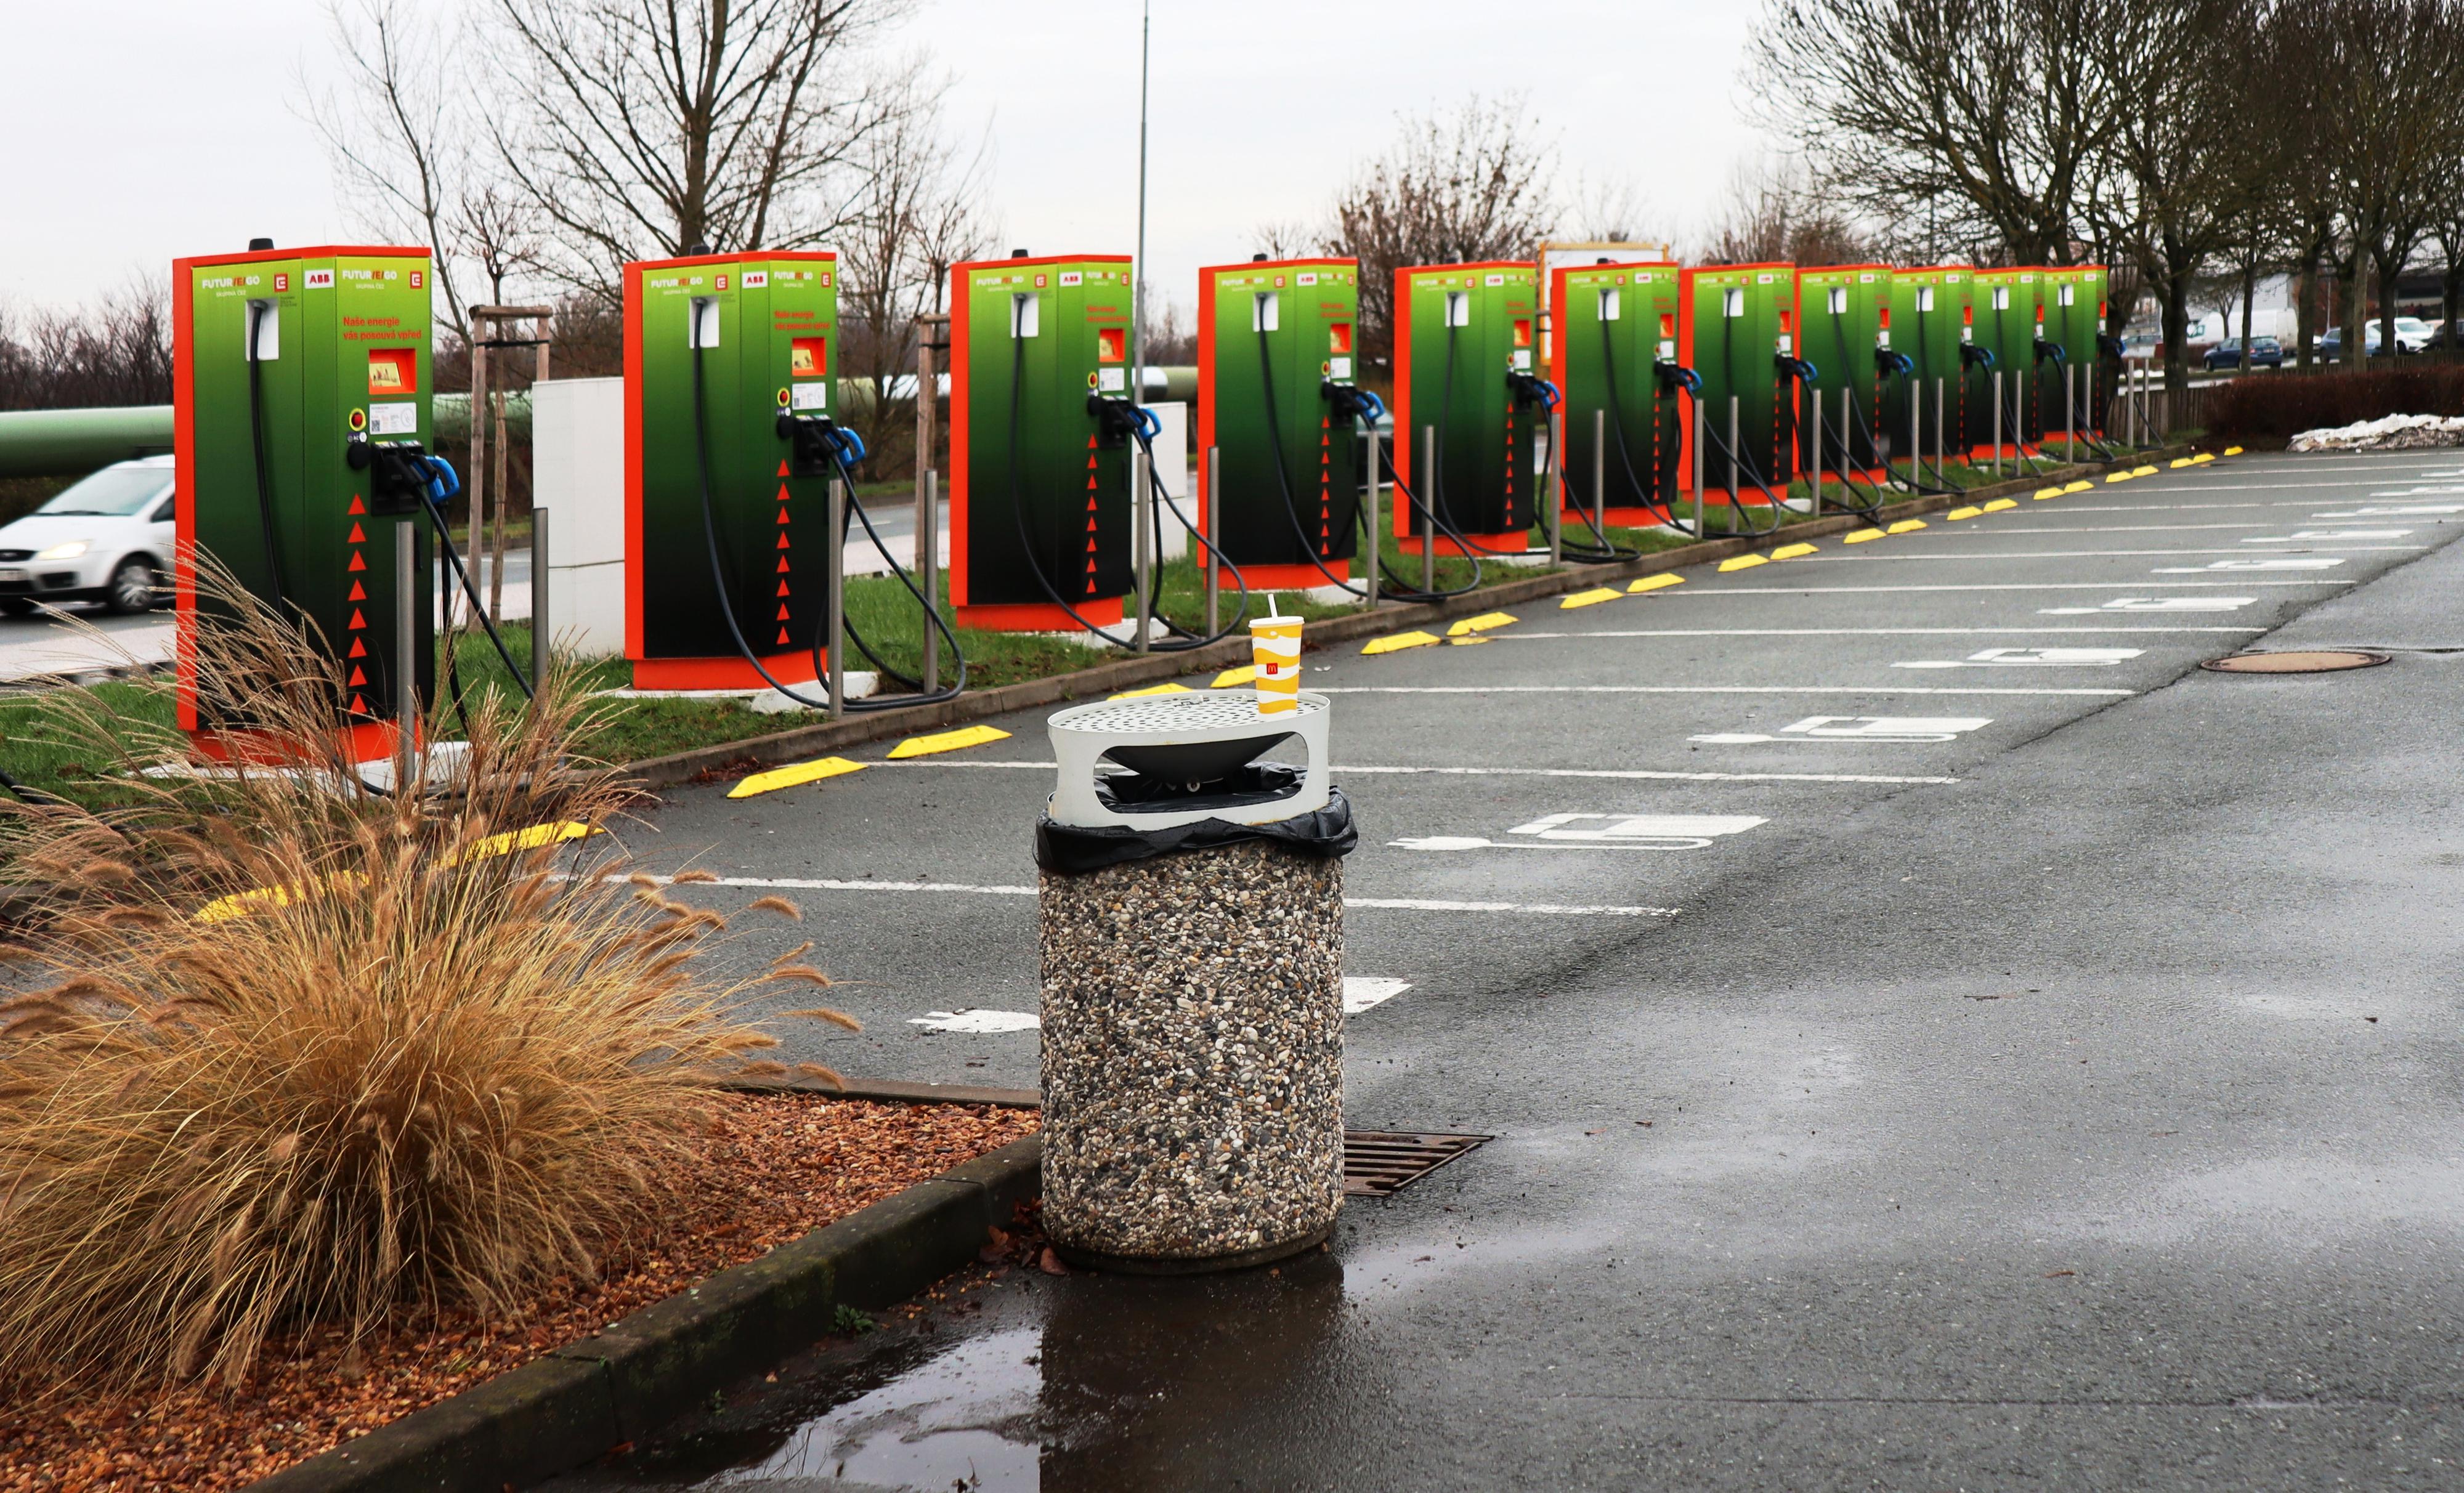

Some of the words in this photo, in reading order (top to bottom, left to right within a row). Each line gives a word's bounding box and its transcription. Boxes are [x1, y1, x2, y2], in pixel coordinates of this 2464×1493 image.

[309, 273, 330, 284] ABB
[747, 275, 764, 284] ABB
[343, 316, 365, 326] Naše
[367, 317, 400, 328] energie
